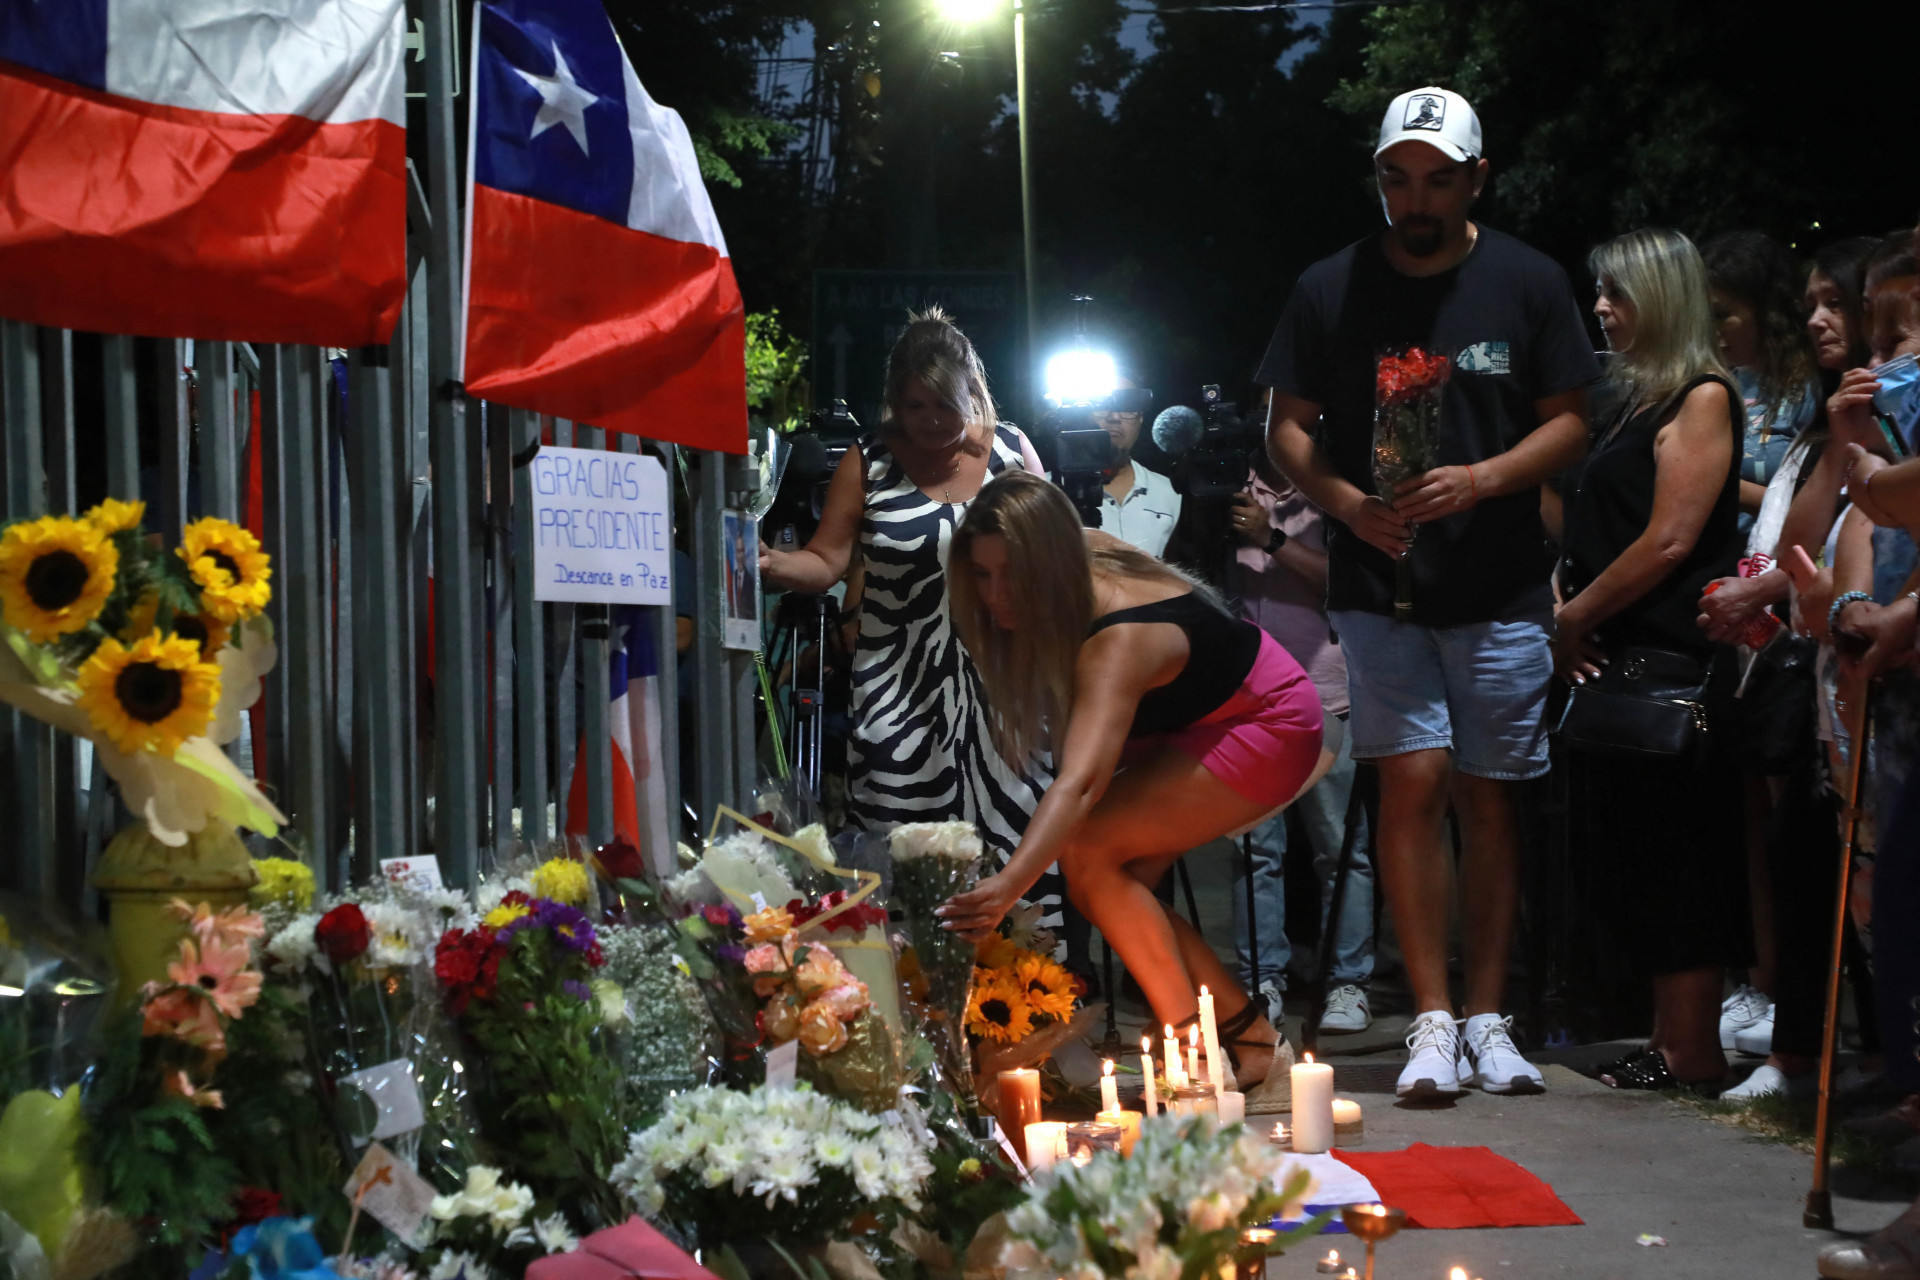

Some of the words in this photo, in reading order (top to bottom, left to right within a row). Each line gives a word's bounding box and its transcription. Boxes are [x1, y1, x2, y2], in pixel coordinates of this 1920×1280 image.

[826, 285, 841, 309] A
[880, 285, 919, 309] LAS
[925, 286, 1007, 310] CONDES
[534, 455, 639, 501] GRACIAS
[539, 508, 665, 551] PRESIDENTE
[554, 563, 614, 586] Descance
[621, 573, 634, 588] en
[636, 562, 669, 590] Paz
